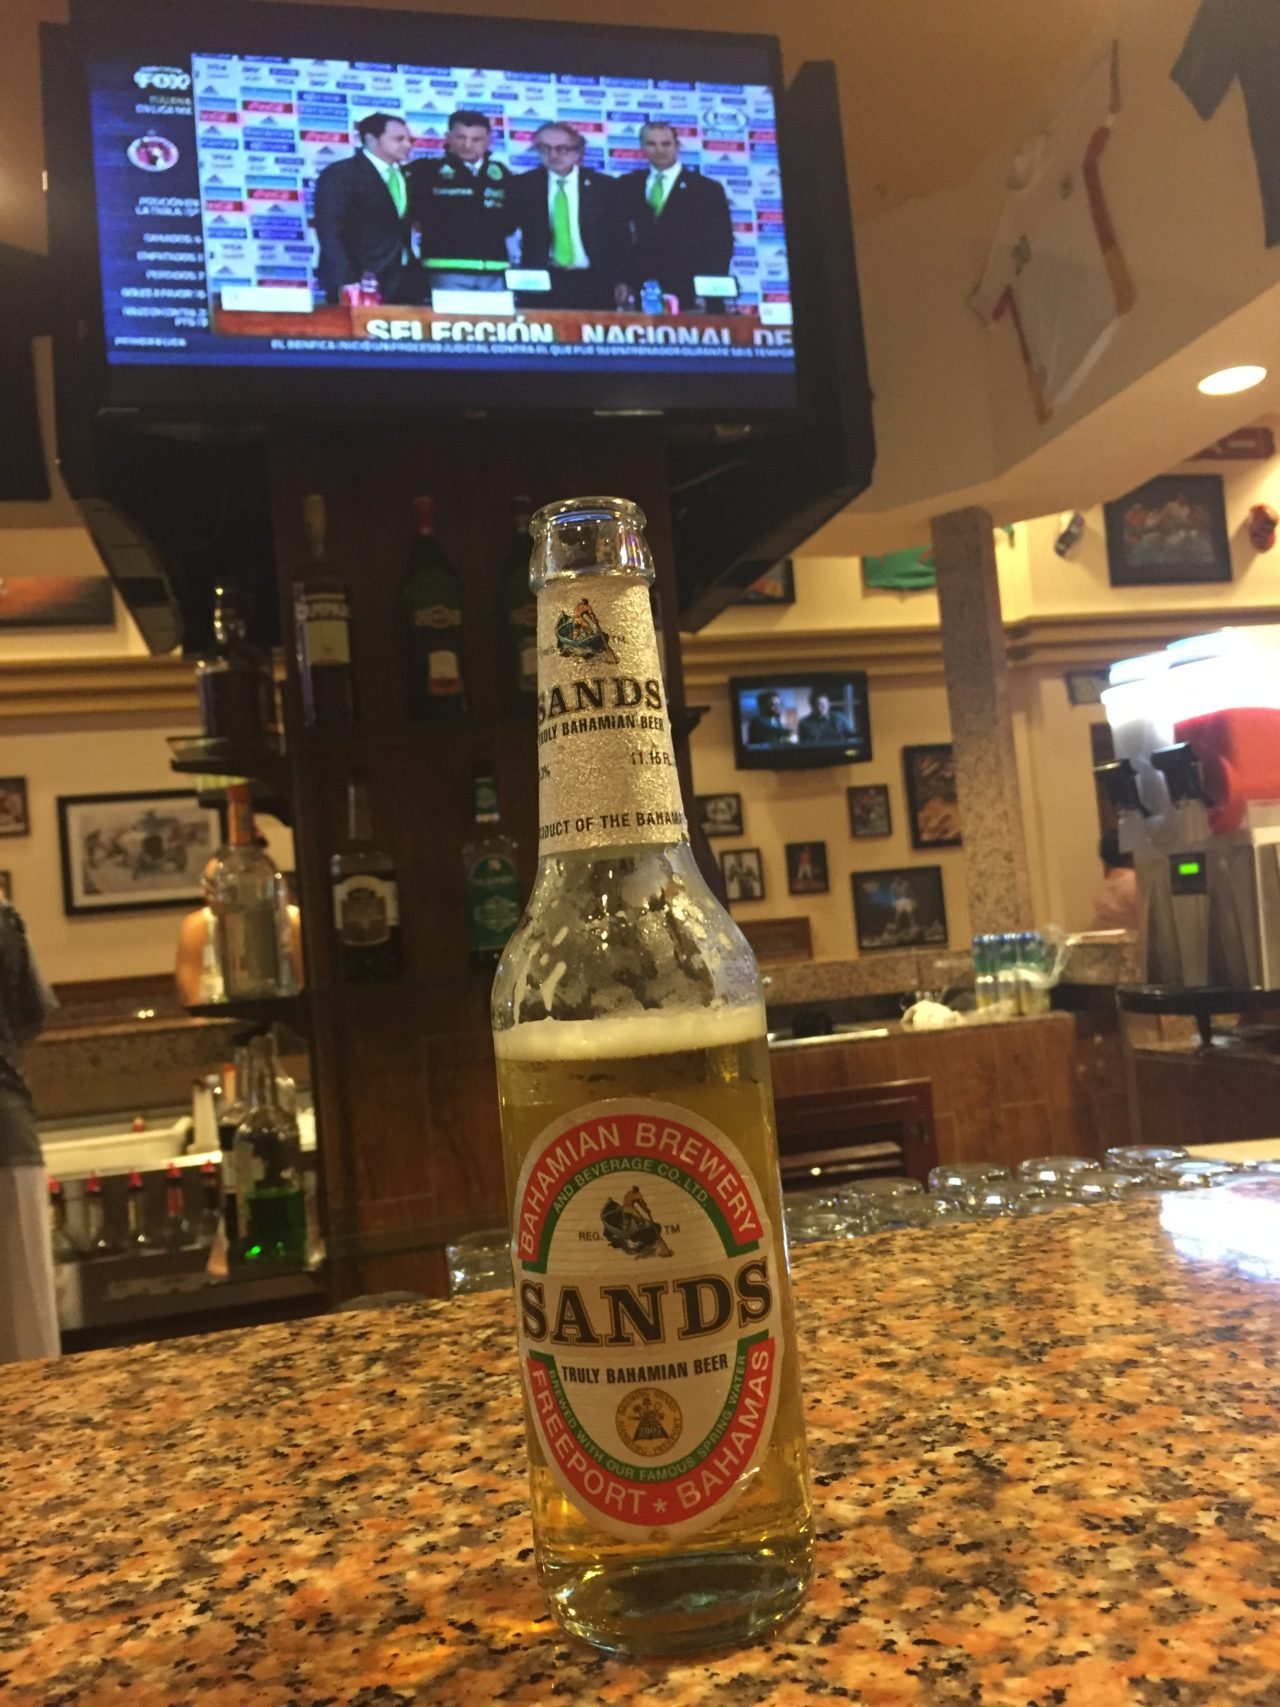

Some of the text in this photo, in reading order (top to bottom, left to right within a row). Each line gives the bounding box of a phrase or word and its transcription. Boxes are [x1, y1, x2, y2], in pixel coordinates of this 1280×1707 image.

[562, 715, 636, 736] BAHAMIAN
[640, 715, 665, 732] BEER
[575, 816, 594, 833] OF
[599, 812, 631, 829] THE
[520, 1121, 757, 1256] BAHAMIAN BREWERY
[552, 1184, 575, 1214] AND
[573, 1157, 653, 1187] BEVERAGE
[663, 1224, 681, 1235] TM
[519, 1255, 774, 1347] SANDS
[561, 1353, 729, 1384] TRULY BAHAMIAN BEER
[532, 1369, 647, 1515] FREEPORT
[676, 1350, 770, 1510] BAHAMAS
[576, 1429, 604, 1462] WITH
[606, 1460, 635, 1480] OUR
[639, 1456, 696, 1481] FAMOUS
[697, 1410, 733, 1459] SPRING
[728, 1355, 747, 1405] WATER
